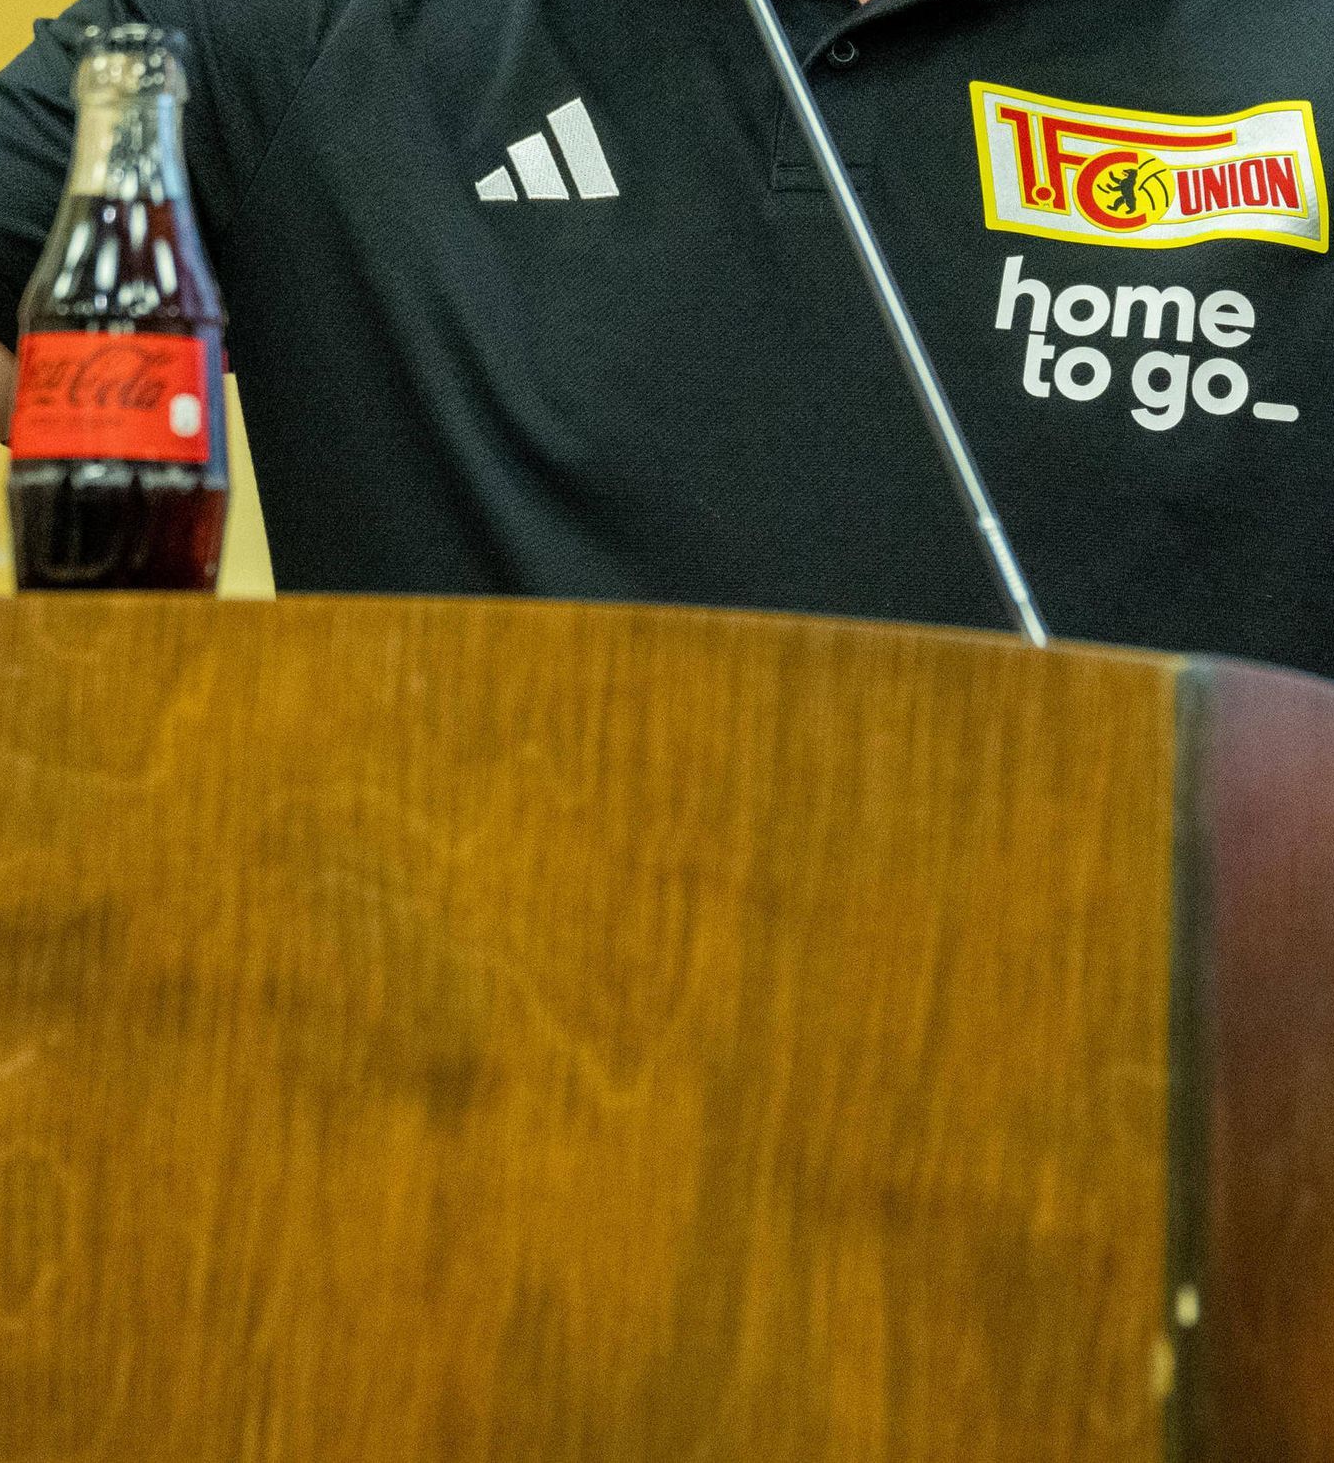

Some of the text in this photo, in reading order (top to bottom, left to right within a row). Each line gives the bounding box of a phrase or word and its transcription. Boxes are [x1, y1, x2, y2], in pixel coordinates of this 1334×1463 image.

[1175, 155, 1301, 217] UNION
[995, 255, 1255, 348] home
[1023, 333, 1112, 401] to
